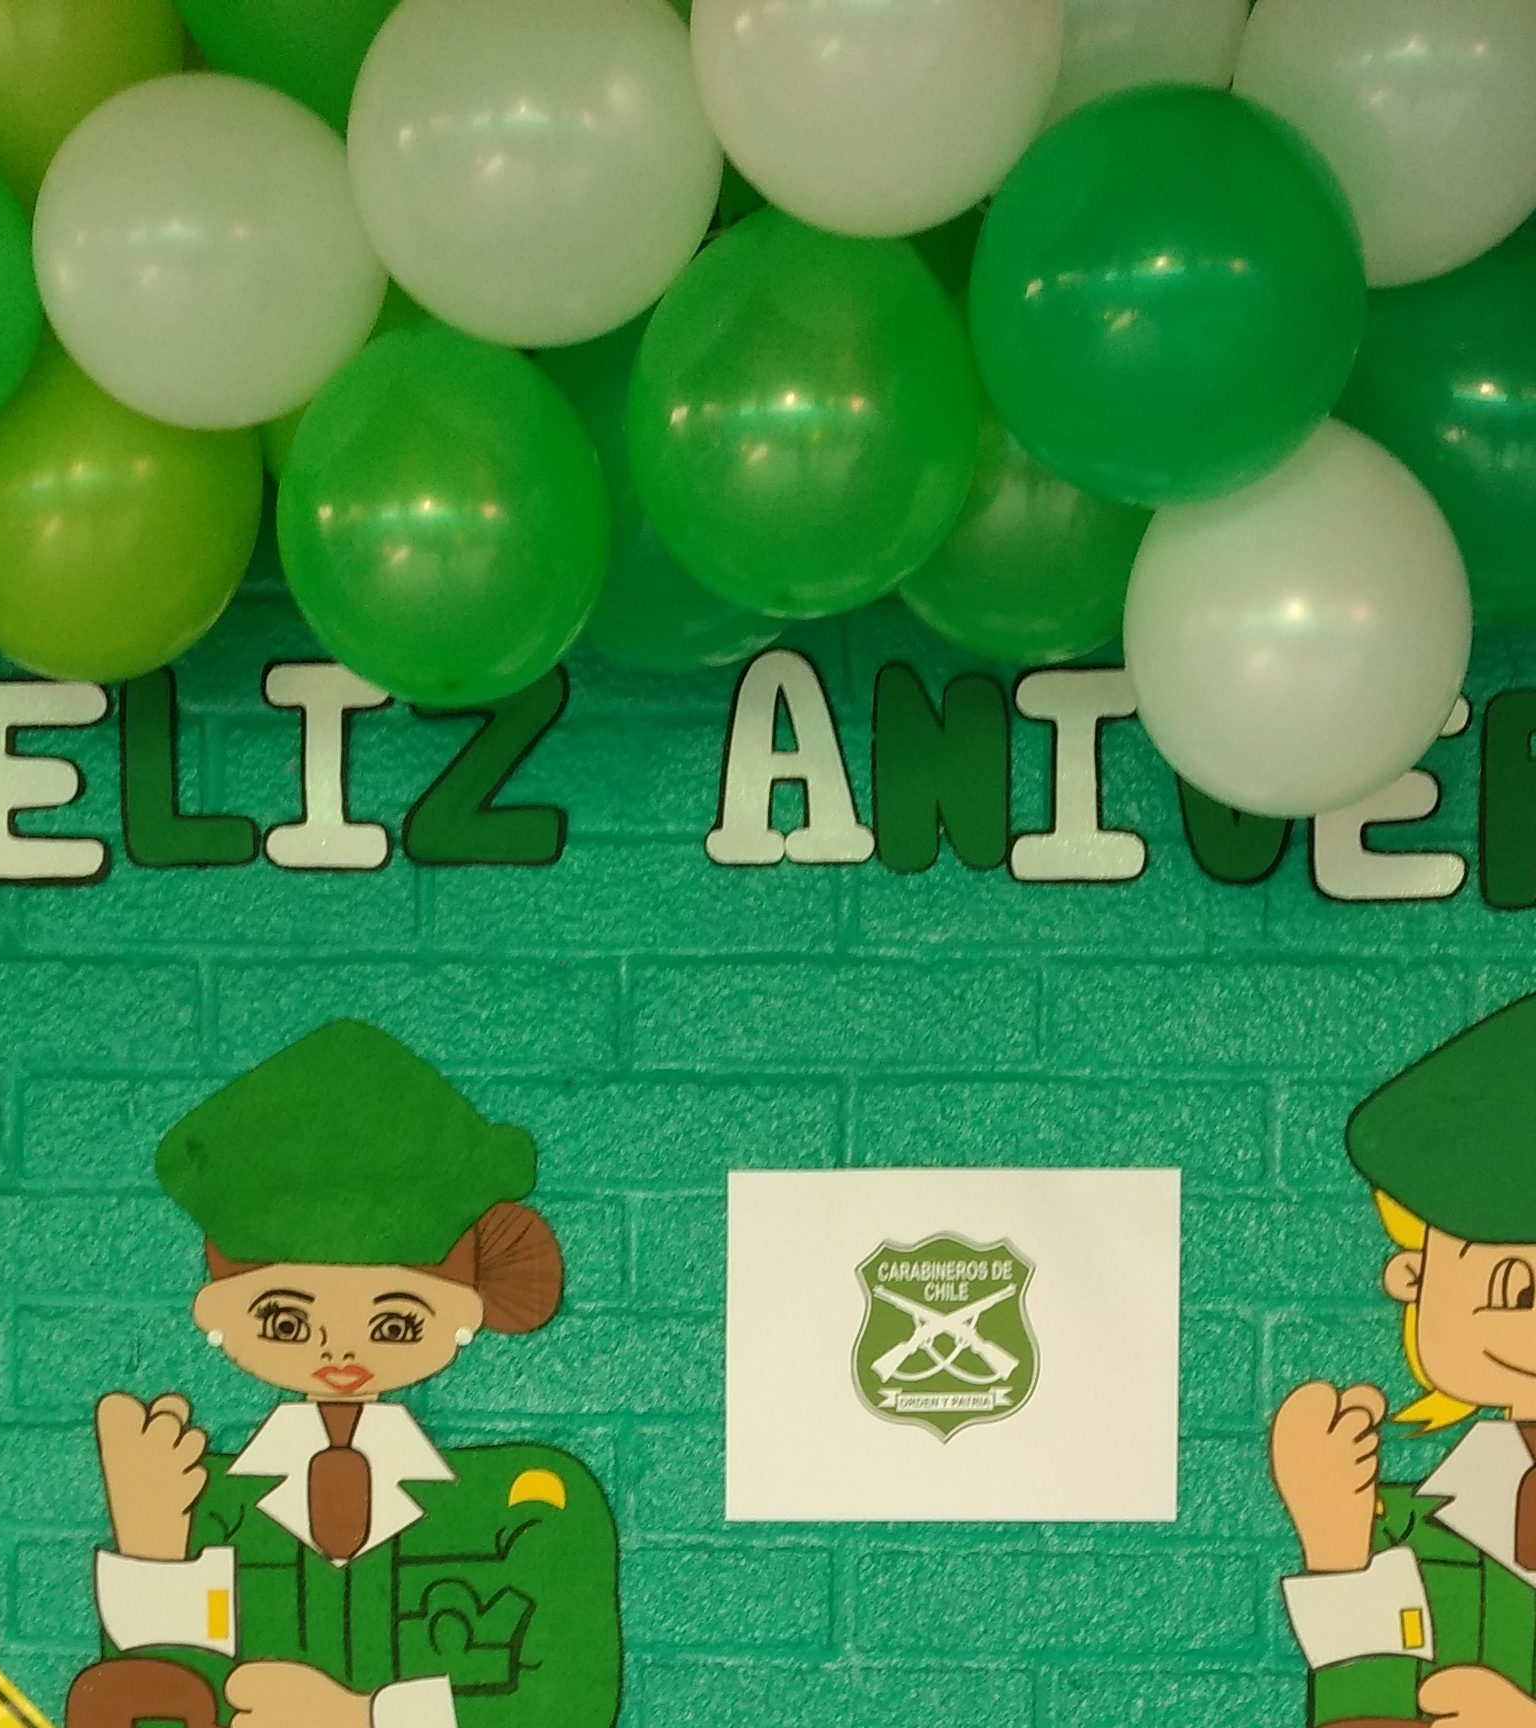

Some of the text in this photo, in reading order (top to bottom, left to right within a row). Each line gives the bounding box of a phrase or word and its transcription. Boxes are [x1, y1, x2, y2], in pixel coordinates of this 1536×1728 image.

[877, 1259, 1014, 1282] CARABINEROS DE
[923, 1281, 970, 1302] CHILE
[898, 1395, 939, 1409] ORDEN
